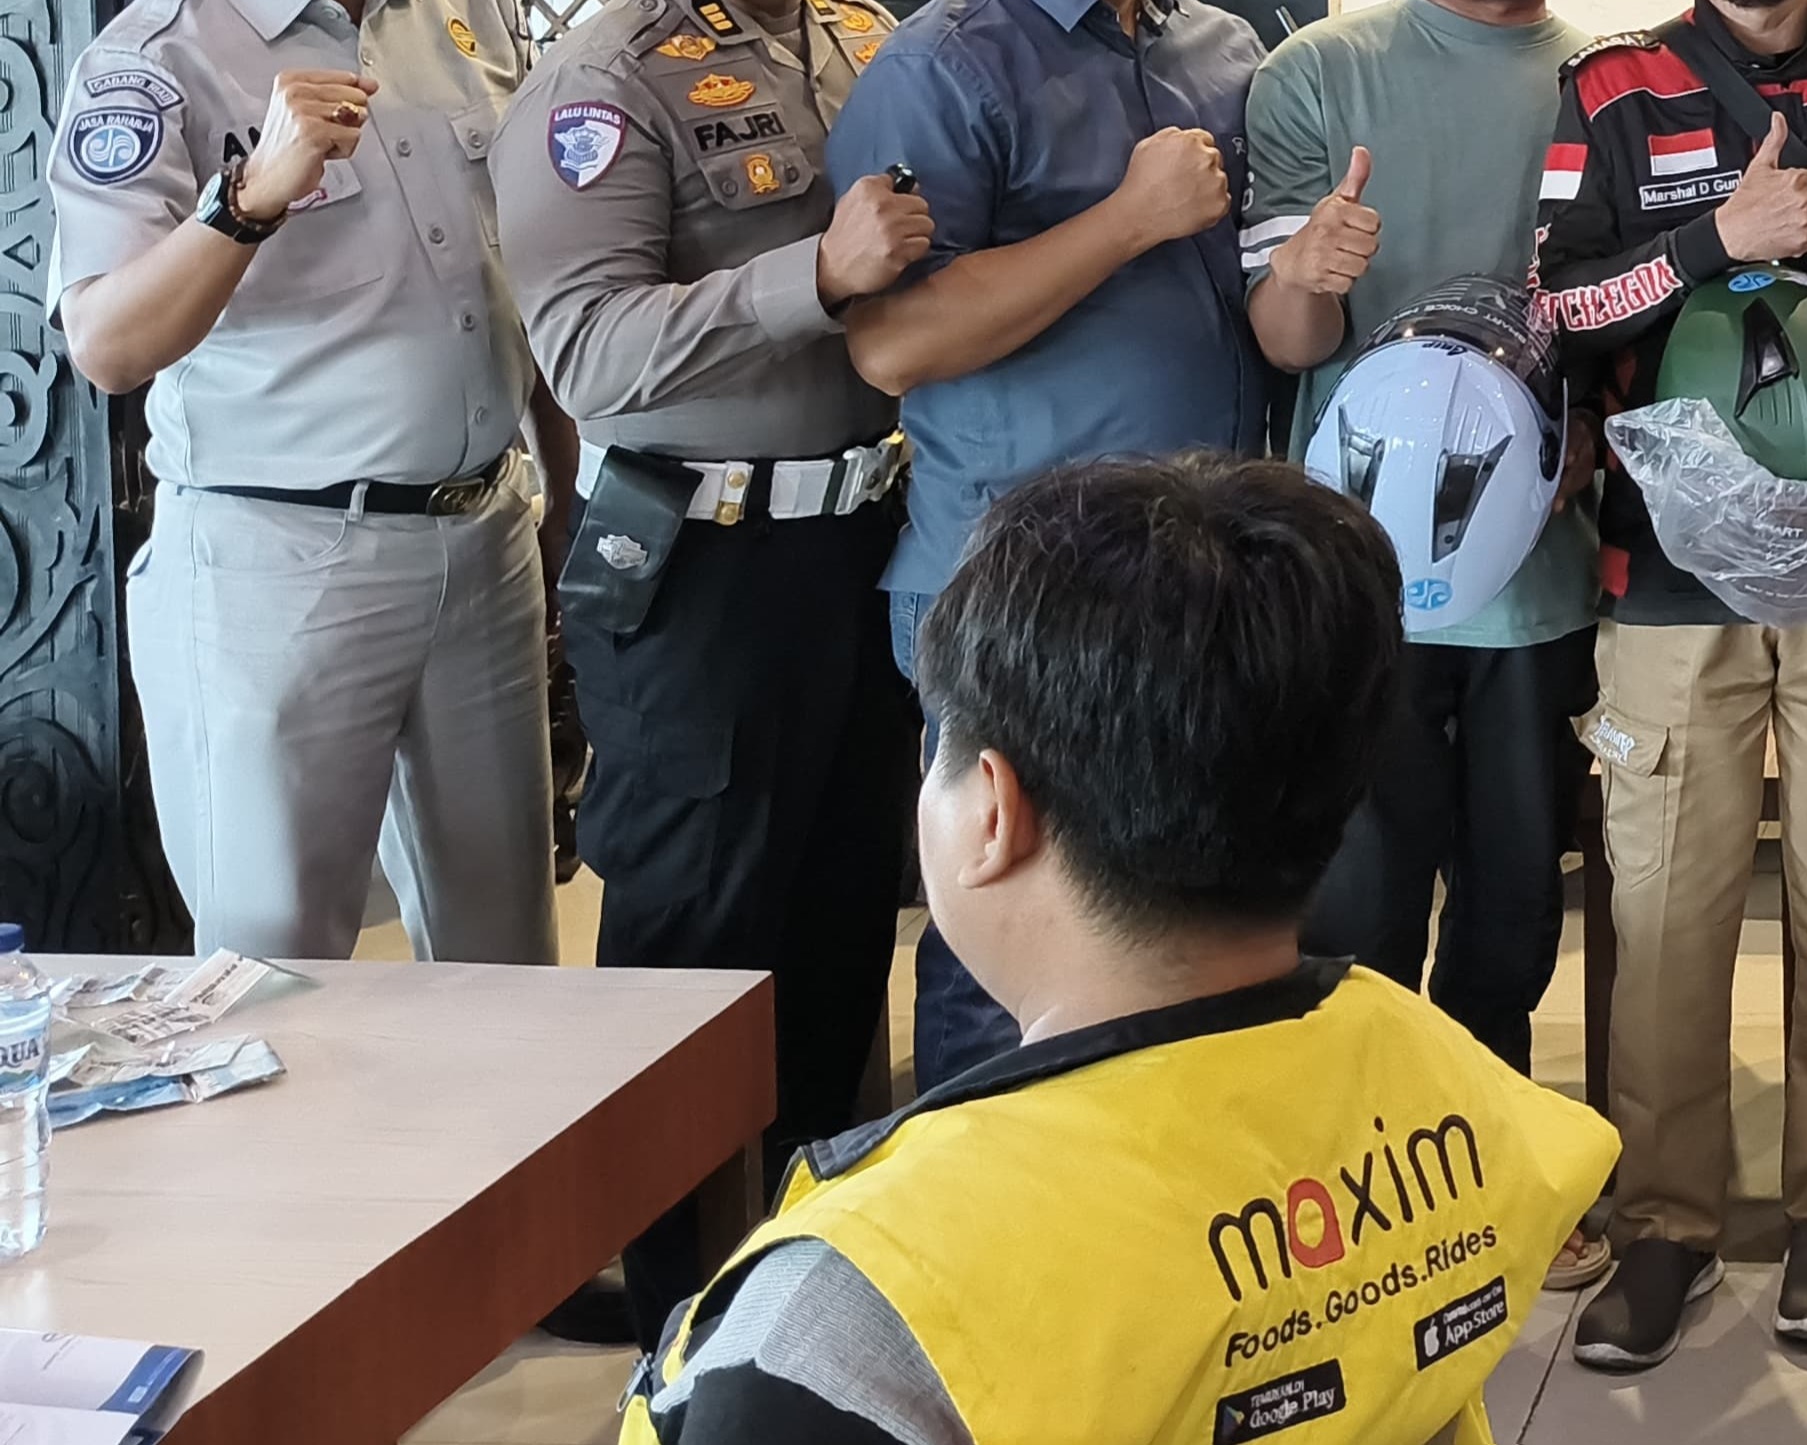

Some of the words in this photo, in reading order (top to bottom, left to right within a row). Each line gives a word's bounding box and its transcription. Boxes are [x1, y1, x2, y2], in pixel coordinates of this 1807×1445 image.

[79, 115, 105, 131] JASA
[106, 115, 154, 133] RAHARJA
[555, 106, 582, 121] LALU
[584, 106, 621, 125] LINTAS
[694, 111, 786, 152] FAJRI
[1644, 182, 1697, 204] Marshal
[1699, 181, 1710, 195] D
[0, 1037, 40, 1068] QUA
[1208, 1115, 1484, 1302] maxim
[1249, 1398, 1299, 1429] Google
[1302, 1386, 1336, 1412] Play
